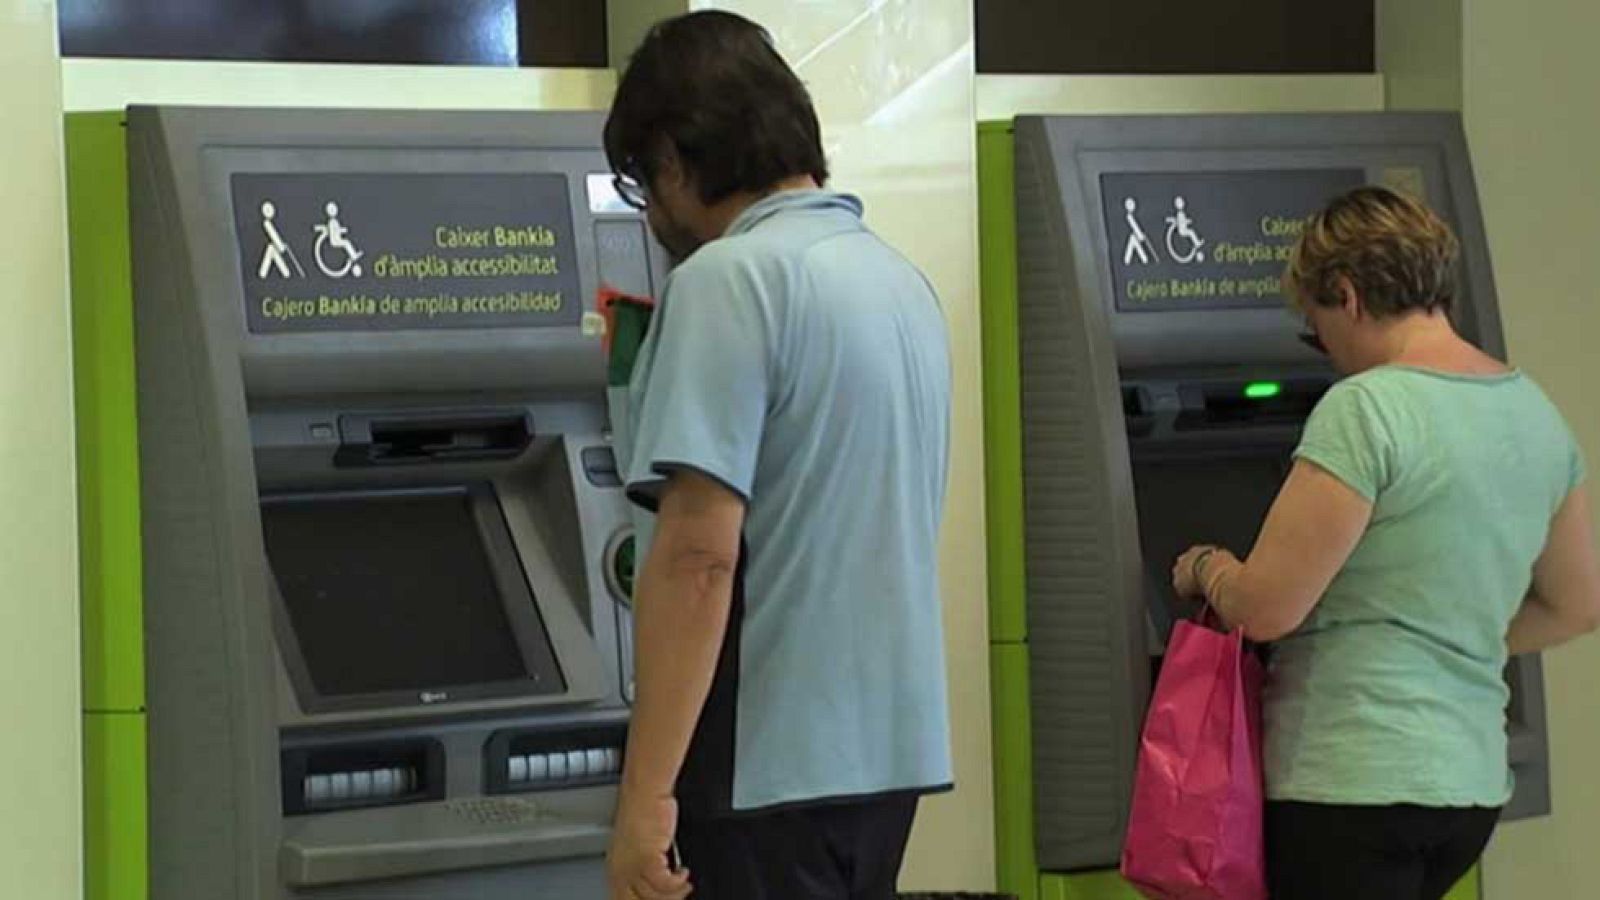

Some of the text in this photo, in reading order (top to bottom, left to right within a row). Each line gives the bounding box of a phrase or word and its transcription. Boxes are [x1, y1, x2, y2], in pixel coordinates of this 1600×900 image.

[436, 225, 555, 248] Caixer Bankia
[452, 252, 559, 277] accessibilitat
[262, 291, 561, 320] Cajero Bankia de amplia accesibilidad
